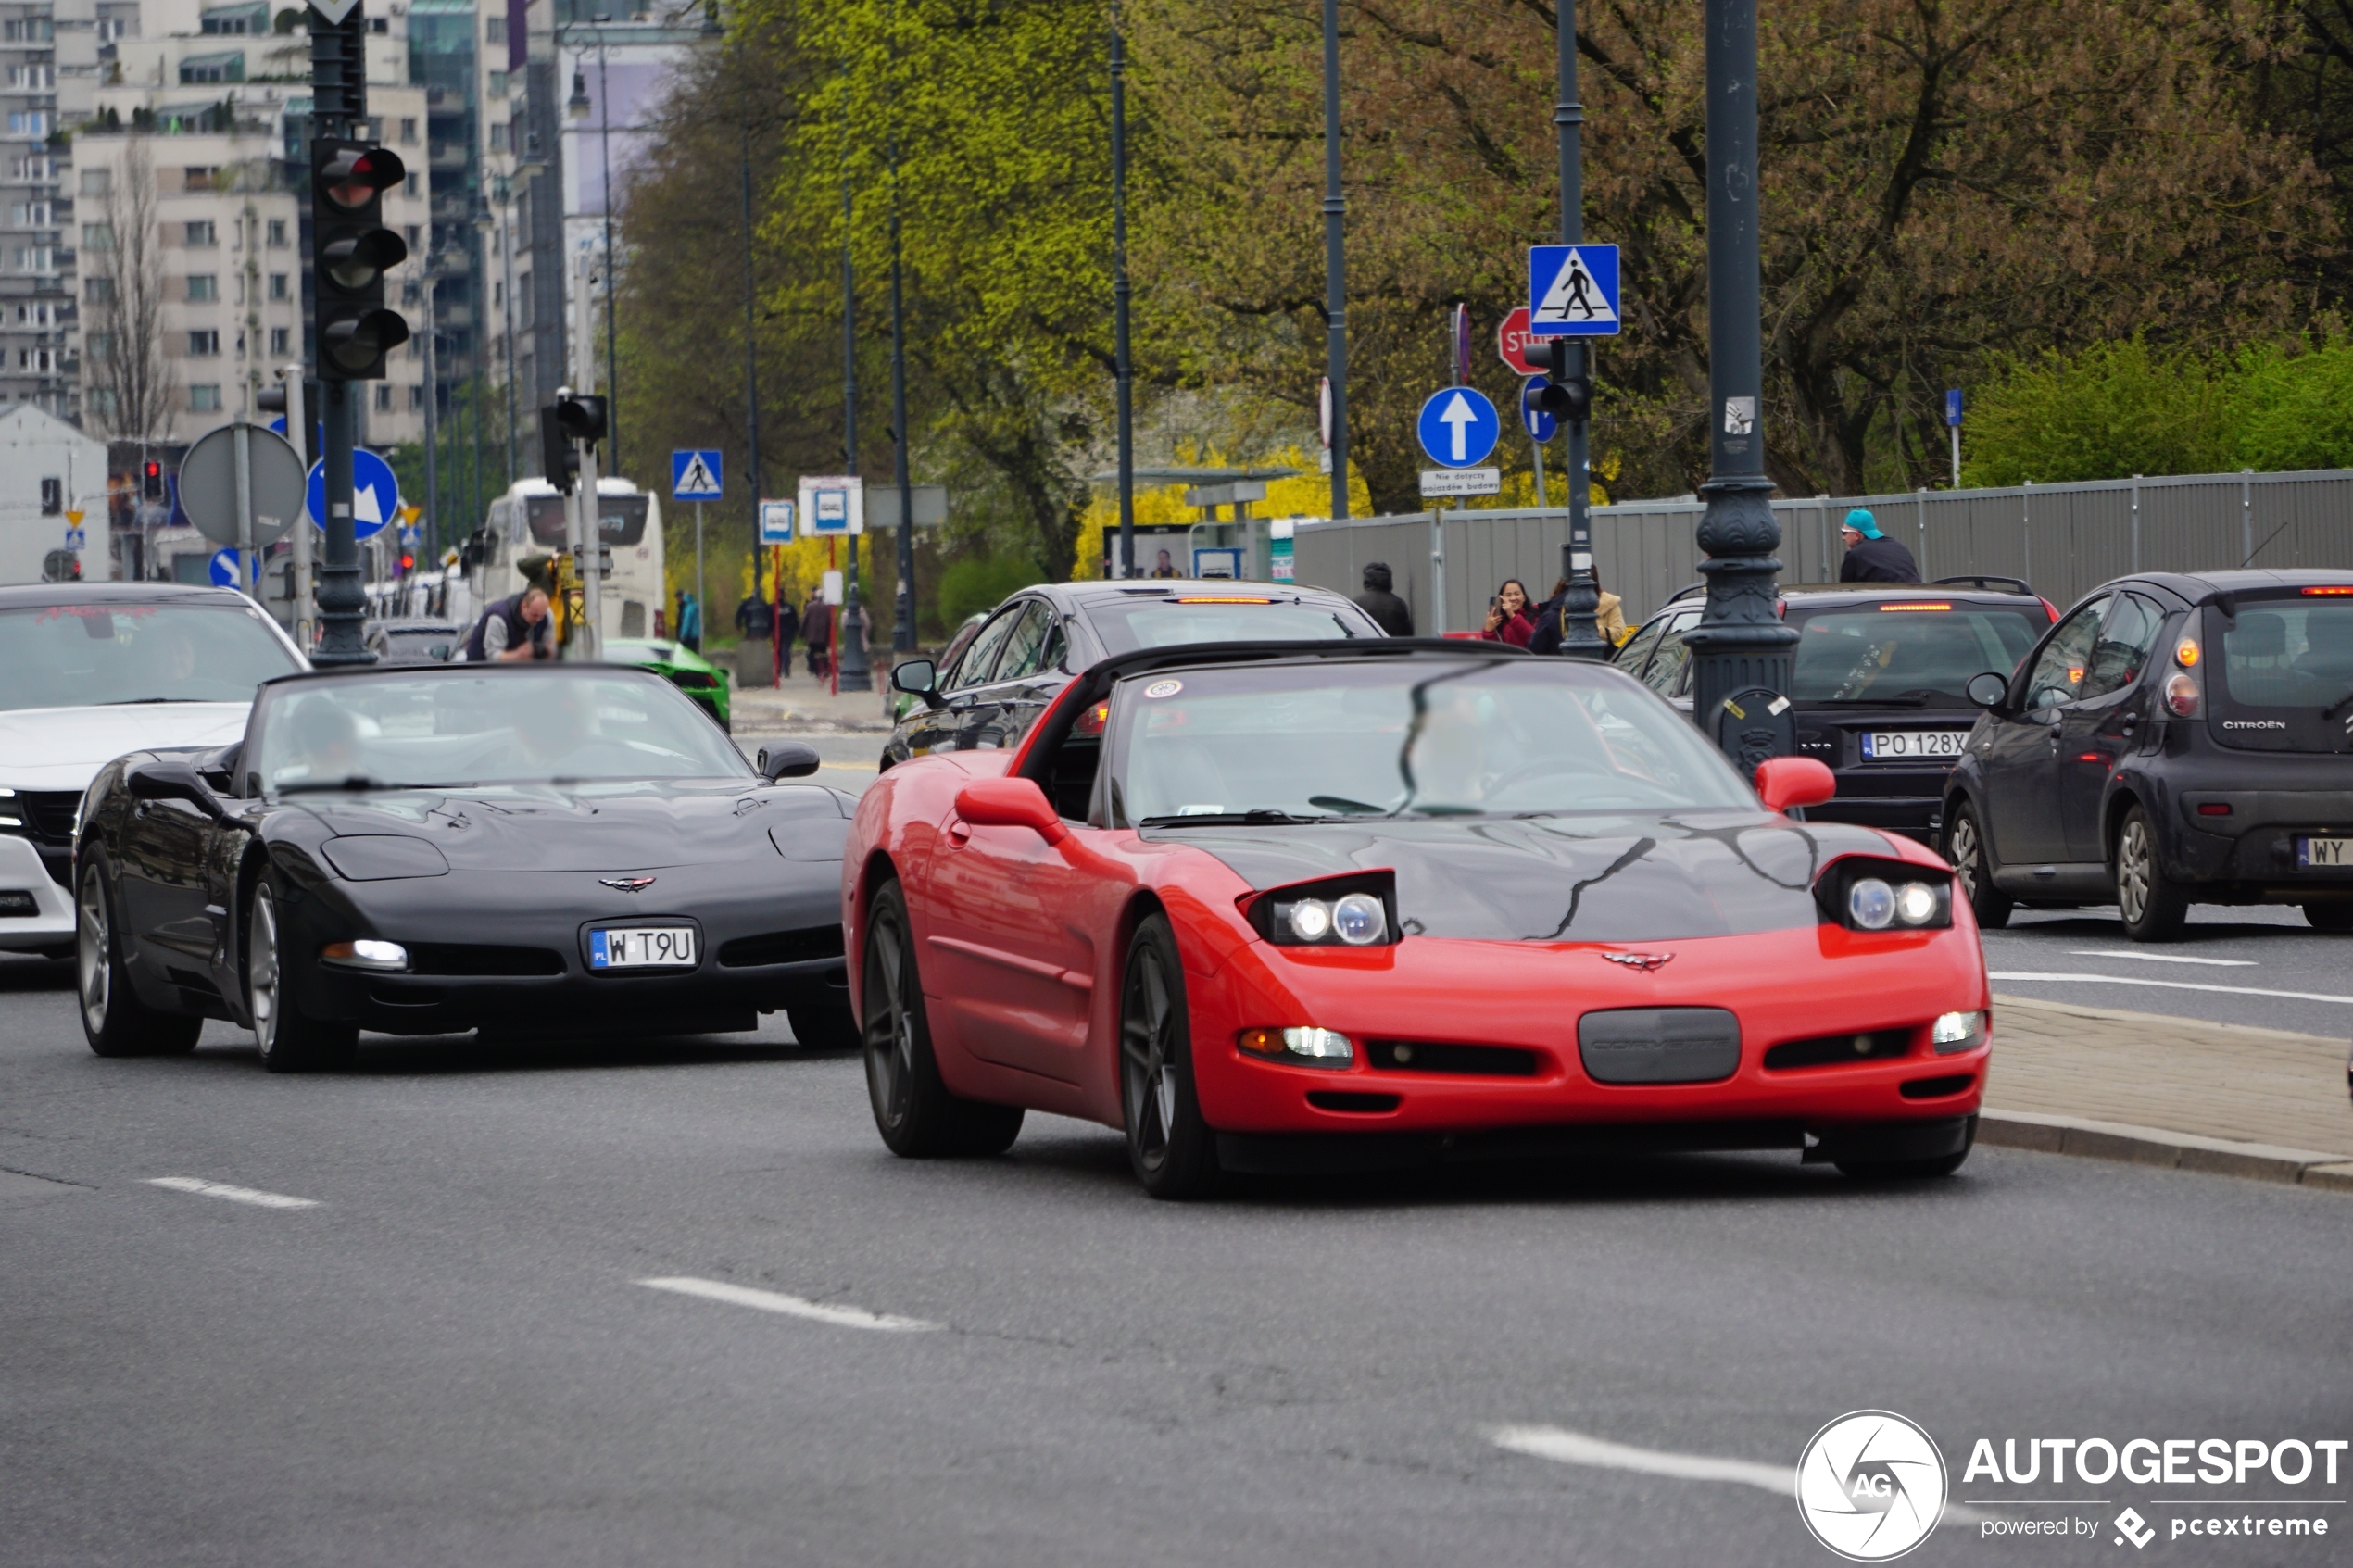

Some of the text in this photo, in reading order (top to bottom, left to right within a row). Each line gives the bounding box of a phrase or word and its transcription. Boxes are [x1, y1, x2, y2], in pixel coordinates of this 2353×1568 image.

[1454, 472, 1486, 482] dotyczy
[1466, 483, 1499, 492] budowy
[2222, 720, 2286, 730] CITROËN
[1875, 734, 1906, 755] PO
[2313, 841, 2344, 864] WY
[595, 932, 690, 962] PL W T9U
[1592, 1036, 1731, 1051] CORVETTE
